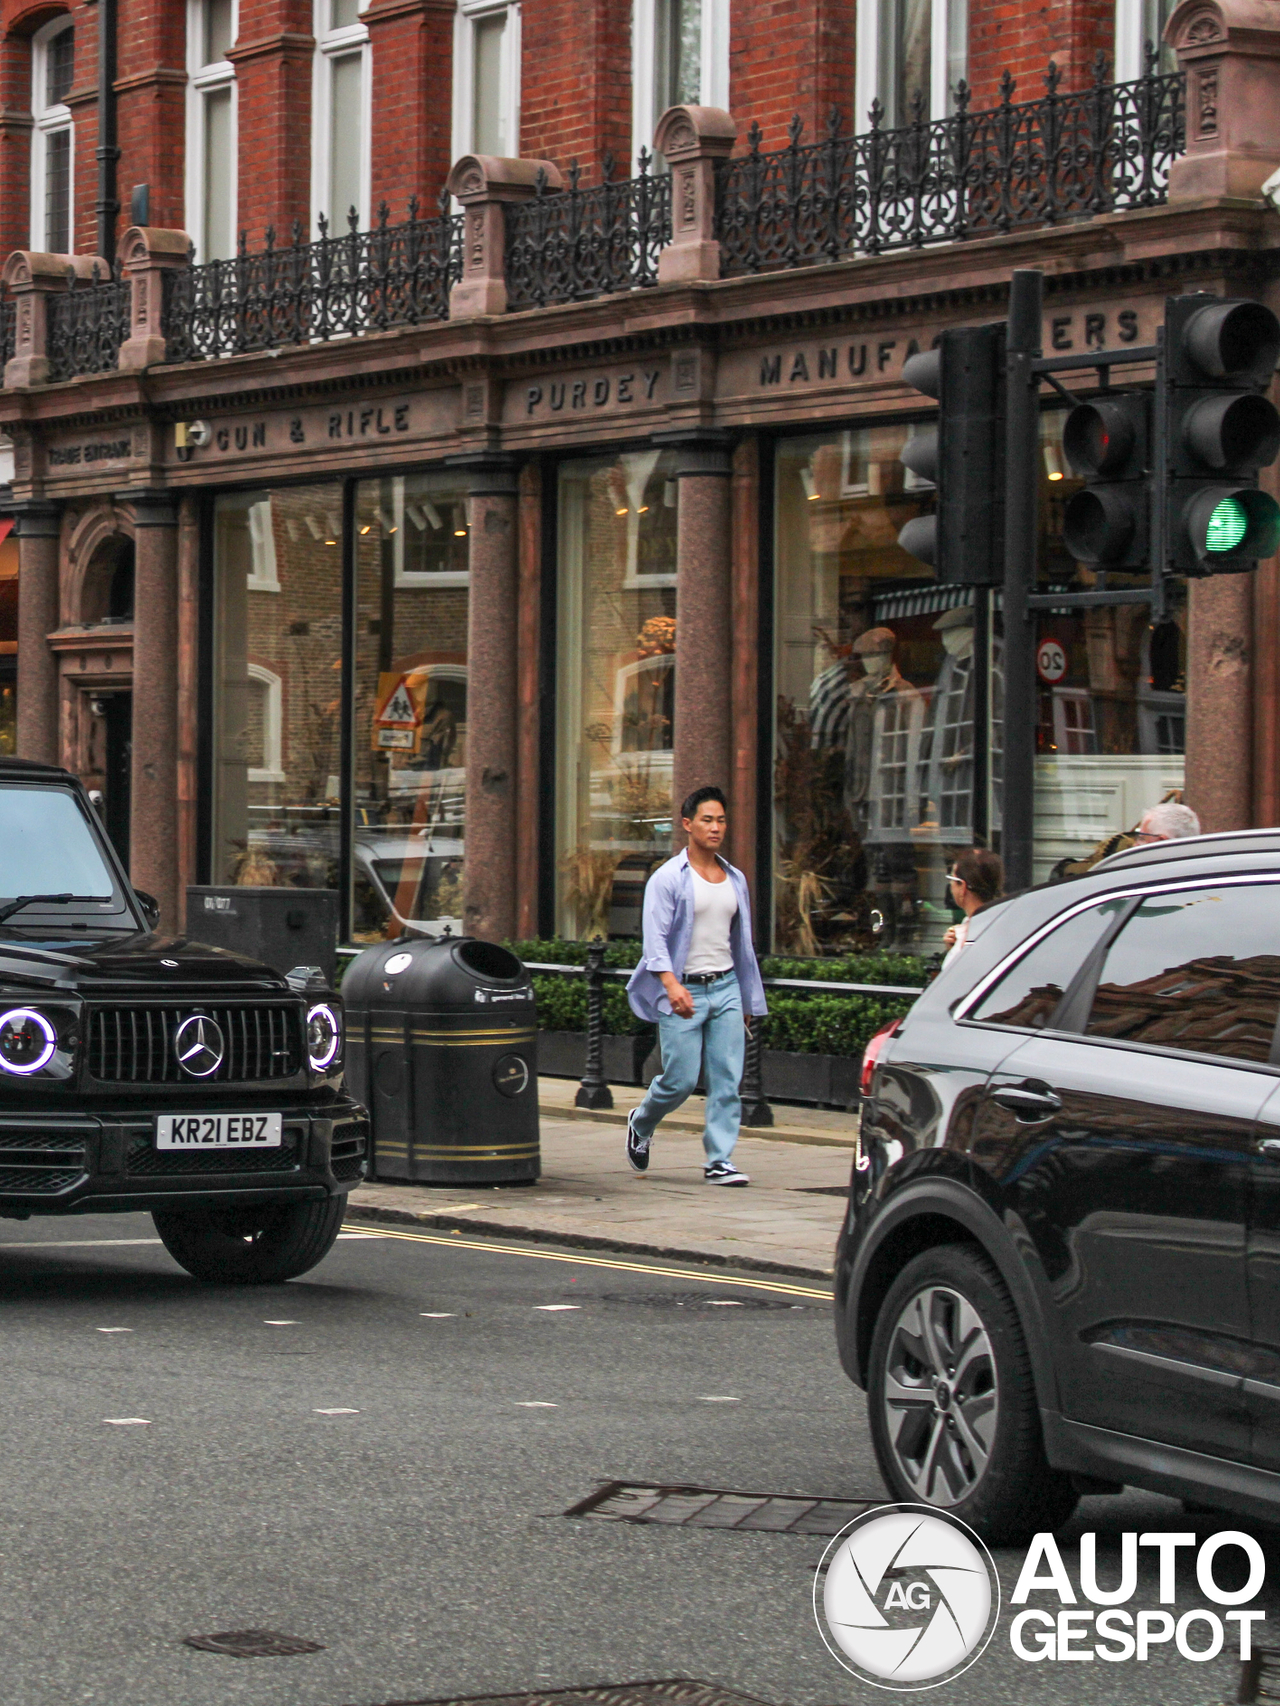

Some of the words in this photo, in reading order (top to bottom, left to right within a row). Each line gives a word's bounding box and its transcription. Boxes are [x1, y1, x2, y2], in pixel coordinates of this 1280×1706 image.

[761, 310, 1138, 386] MANUFAERS
[527, 371, 660, 414] PURDEY
[216, 422, 266, 451] GUN
[290, 415, 305, 443] &
[328, 404, 410, 438] RIFLE
[171, 1118, 221, 1143] KR21
[227, 1117, 268, 1142] EBZ
